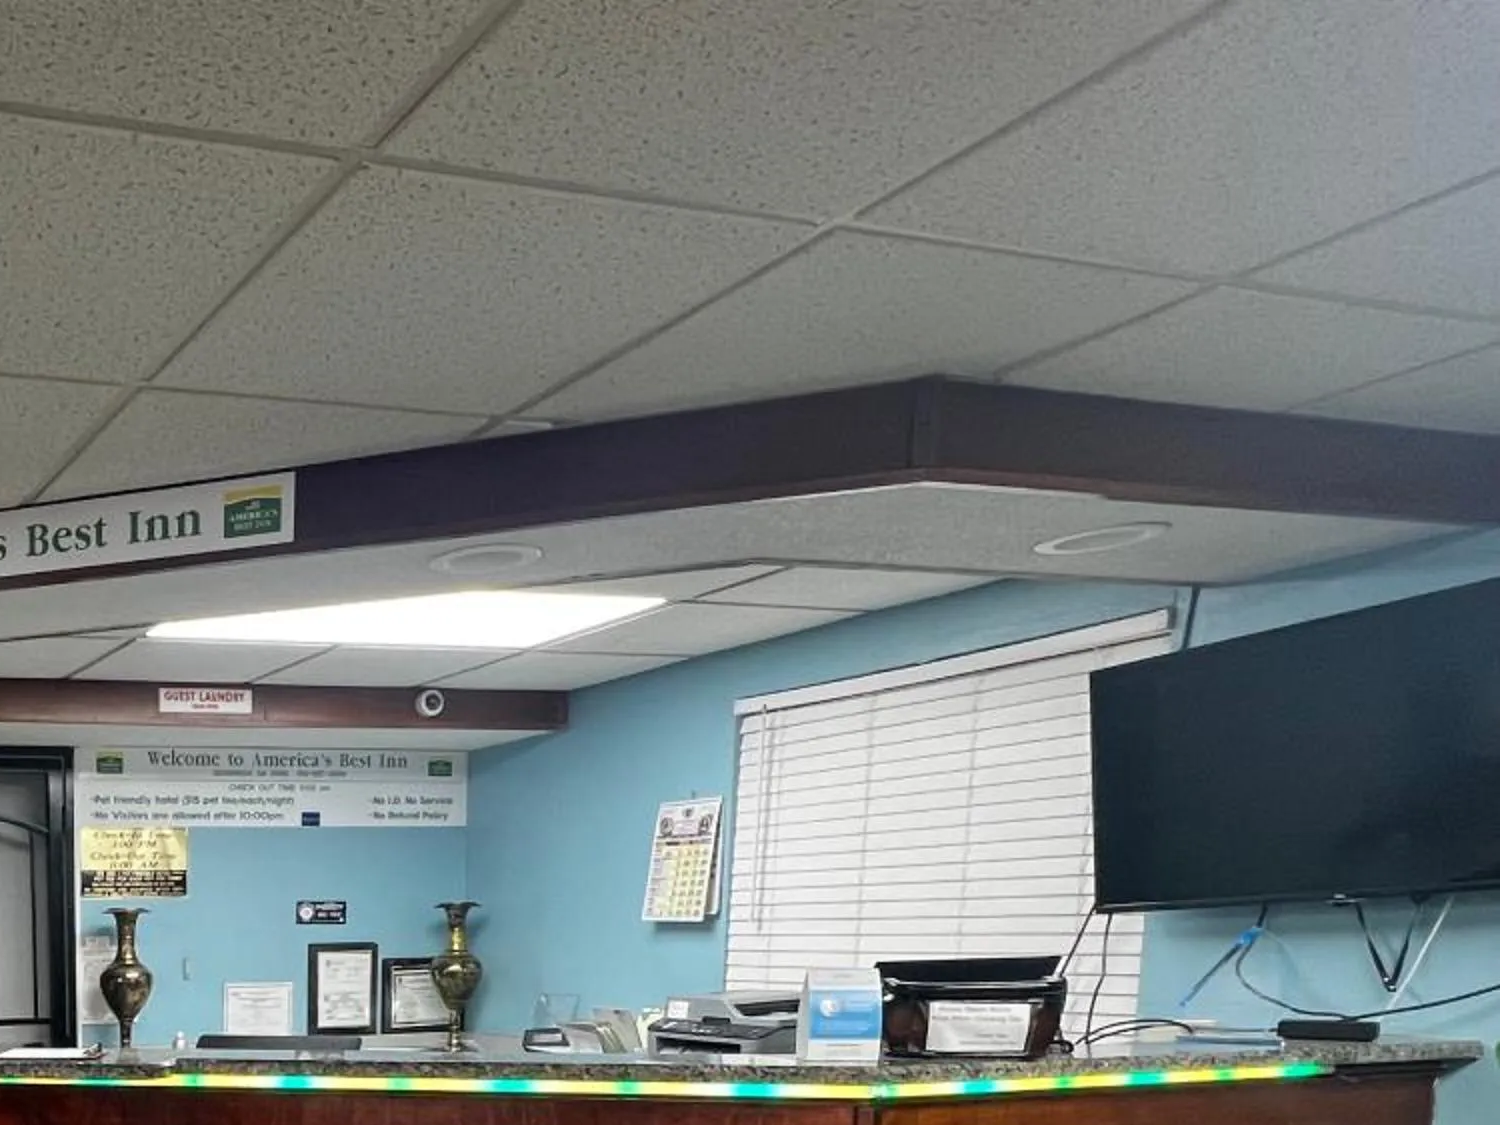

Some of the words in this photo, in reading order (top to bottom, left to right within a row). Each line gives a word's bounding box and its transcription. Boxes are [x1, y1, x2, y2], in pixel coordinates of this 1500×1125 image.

[26, 516, 108, 557] Best
[127, 510, 202, 545] Inn
[163, 690, 196, 702] GUEST
[199, 691, 245, 703] LAUNDRY
[147, 748, 221, 767] Welcome
[228, 753, 244, 767] to
[252, 752, 333, 768] America's
[339, 752, 371, 769] Best
[379, 753, 408, 769] Inn
